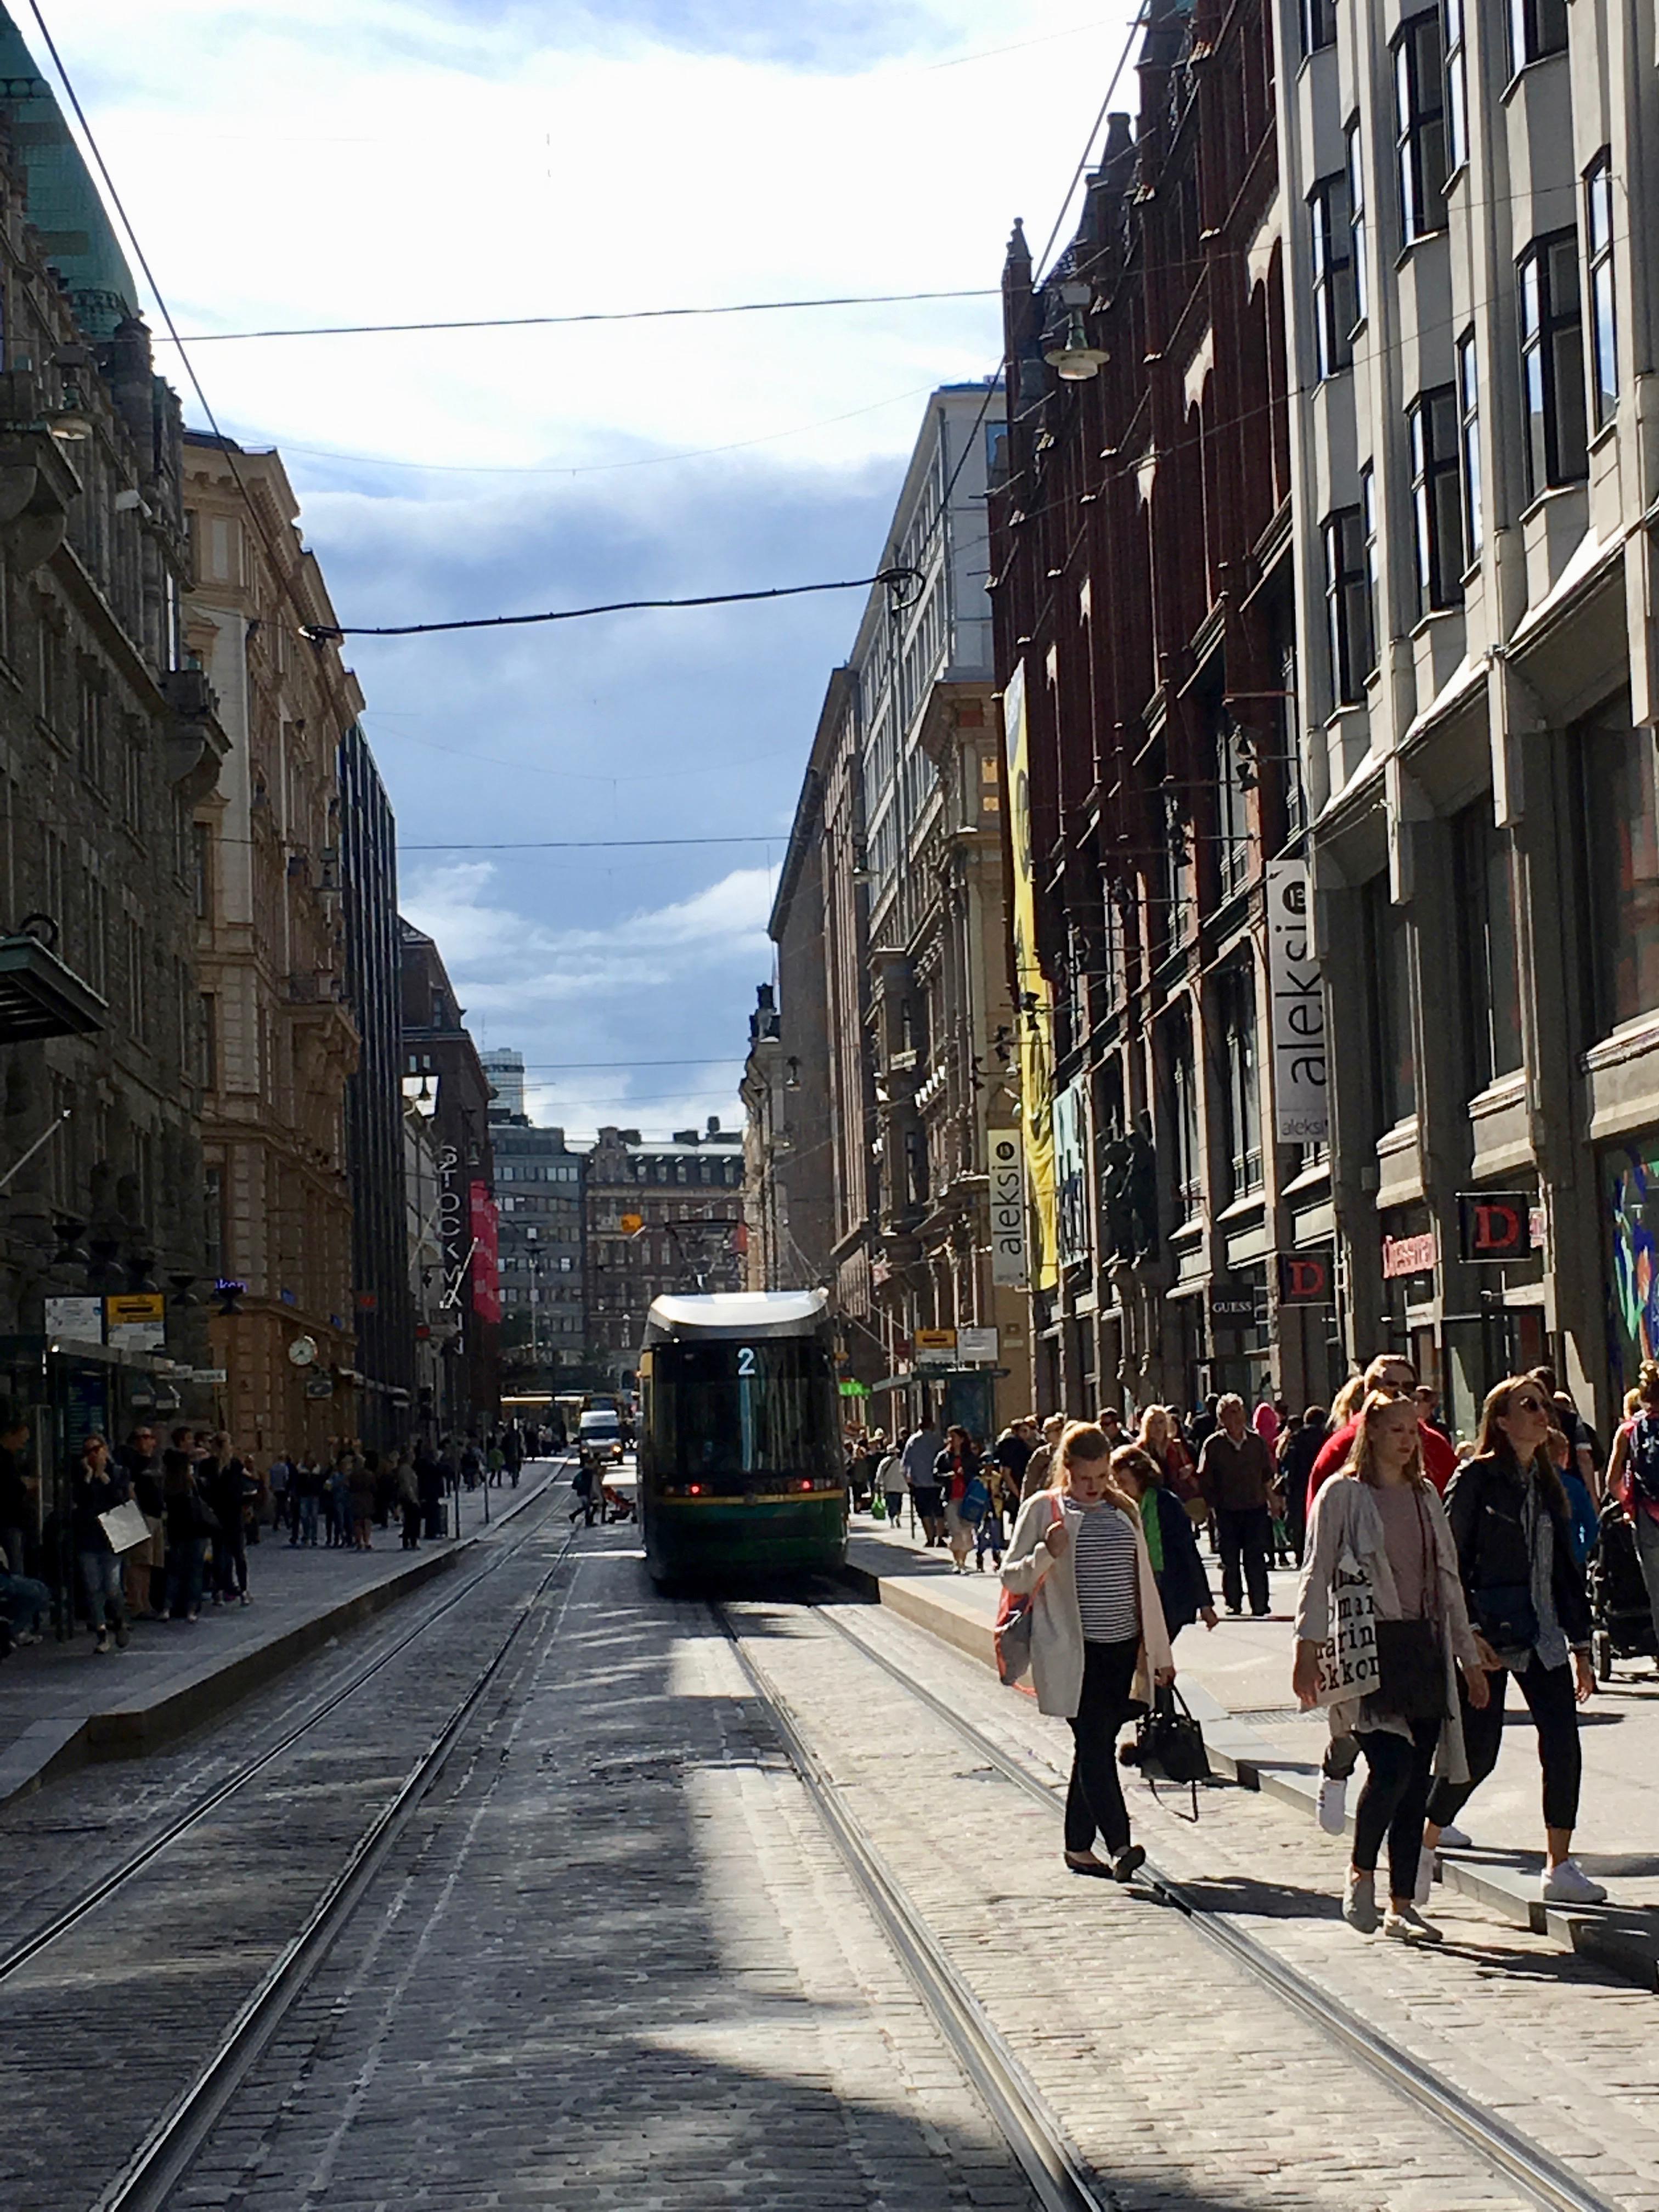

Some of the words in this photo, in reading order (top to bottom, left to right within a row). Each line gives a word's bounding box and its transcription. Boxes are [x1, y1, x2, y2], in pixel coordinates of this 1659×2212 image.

[1274, 925, 1327, 1086] aleksi
[992, 1165, 1022, 1255] aleksi
[1475, 1205, 1520, 1249] D
[1290, 1262, 1324, 1295] D
[1212, 1301, 1252, 1313] GUESS
[737, 1347, 755, 1375] 2
